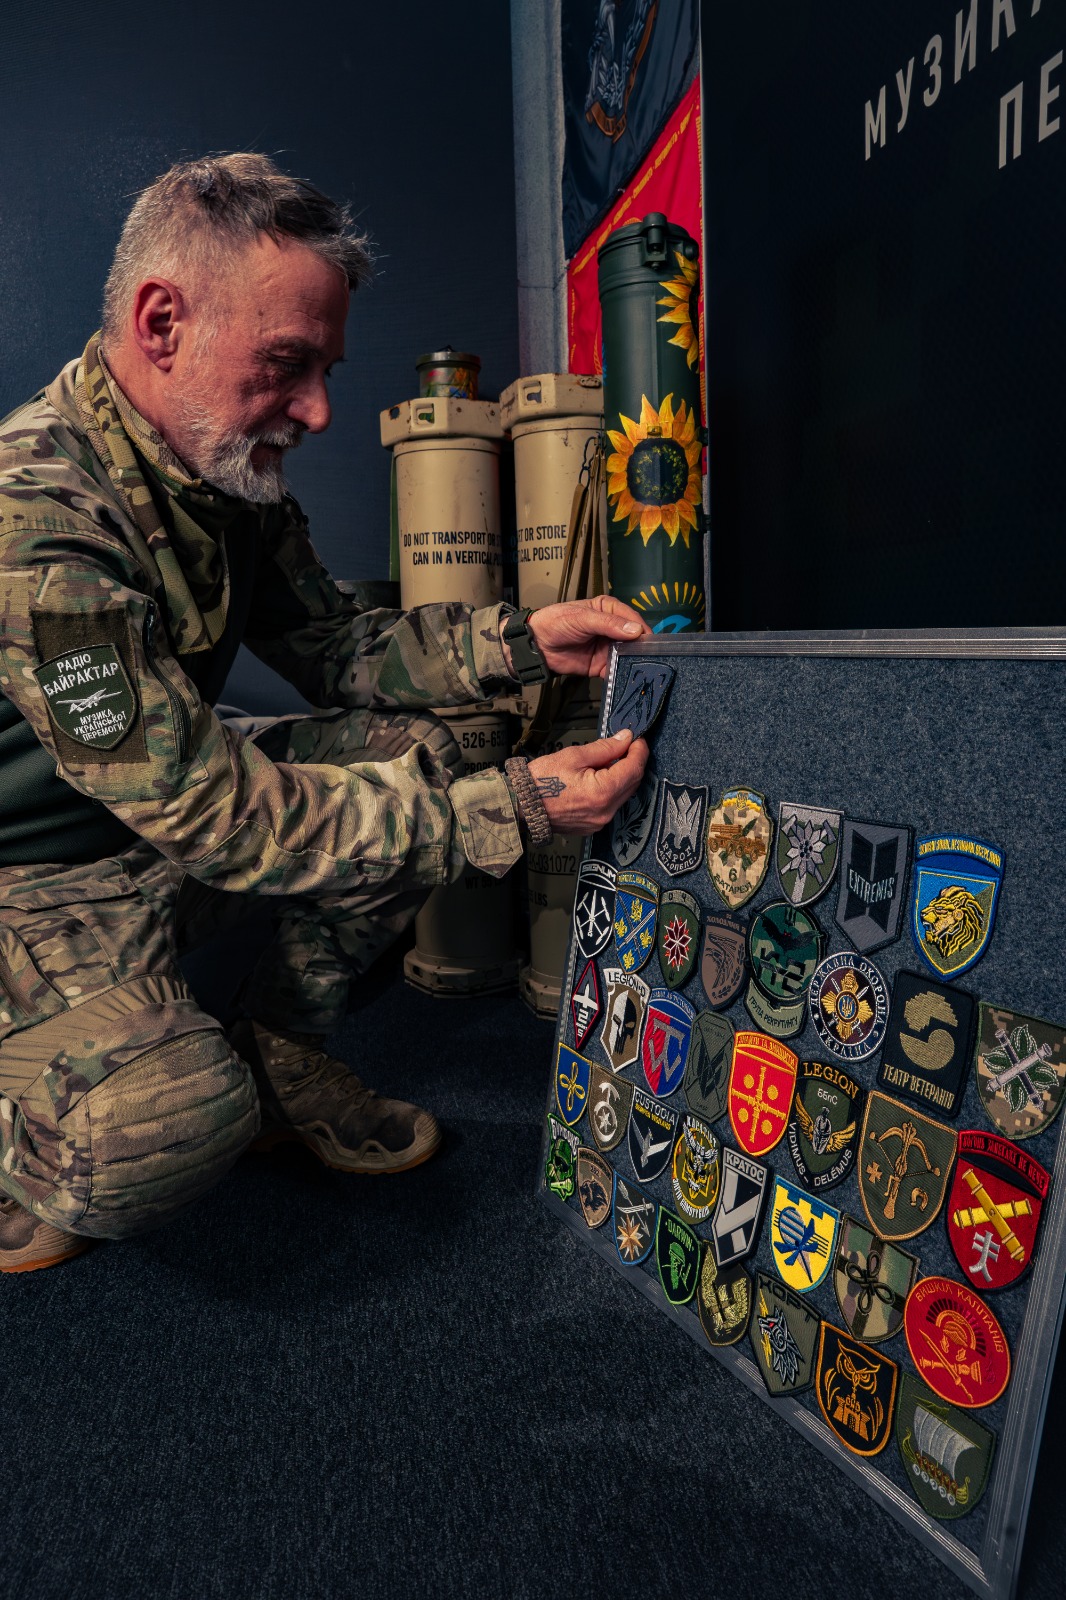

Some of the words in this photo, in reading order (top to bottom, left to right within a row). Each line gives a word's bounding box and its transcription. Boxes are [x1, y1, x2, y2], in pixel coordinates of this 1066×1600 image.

[865, 0, 1041, 161] МУЗИК
[403, 533, 412, 547] DO
[413, 531, 430, 546] NOT
[431, 530, 487, 546] TRANSPORT
[487, 532, 496, 547] OR
[524, 528, 534, 541] OR
[536, 524, 567, 540] STORE
[413, 551, 429, 566] CAN
[432, 551, 443, 565] IN
[445, 550, 453, 565] A
[454, 549, 493, 566] VERTICAL
[56, 653, 92, 673] РАДІО
[43, 662, 119, 697] БАЙРАКТАР
[73, 710, 127, 736] УКРАЇНСЬКОЇ
[79, 708, 113, 725] МУЗИКА
[82, 721, 125, 742] ПЕРЕМОГИ
[581, 863, 617, 883] SIGNUM
[714, 873, 753, 895] БАТАРЕЯ
[728, 868, 738, 883] 6
[849, 868, 895, 904] EXTREMIS
[534, 891, 548, 907] LBS
[810, 955, 855, 1006] ДЕРЖАВНА
[750, 997, 764, 1020] ГРУПА
[764, 1013, 798, 1028] РЕКРУТИНГУ
[761, 1038, 768, 1049] ТА
[802, 1062, 861, 1099] LEGION
[884, 1063, 909, 1090] ТЕАТР
[911, 1074, 955, 1110] ВЕТЕРАНІВ
[634, 1091, 675, 1126] CUSTODIA
[788, 1122, 806, 1175] VIDIMUS
[726, 1152, 764, 1182] КРАТОС
